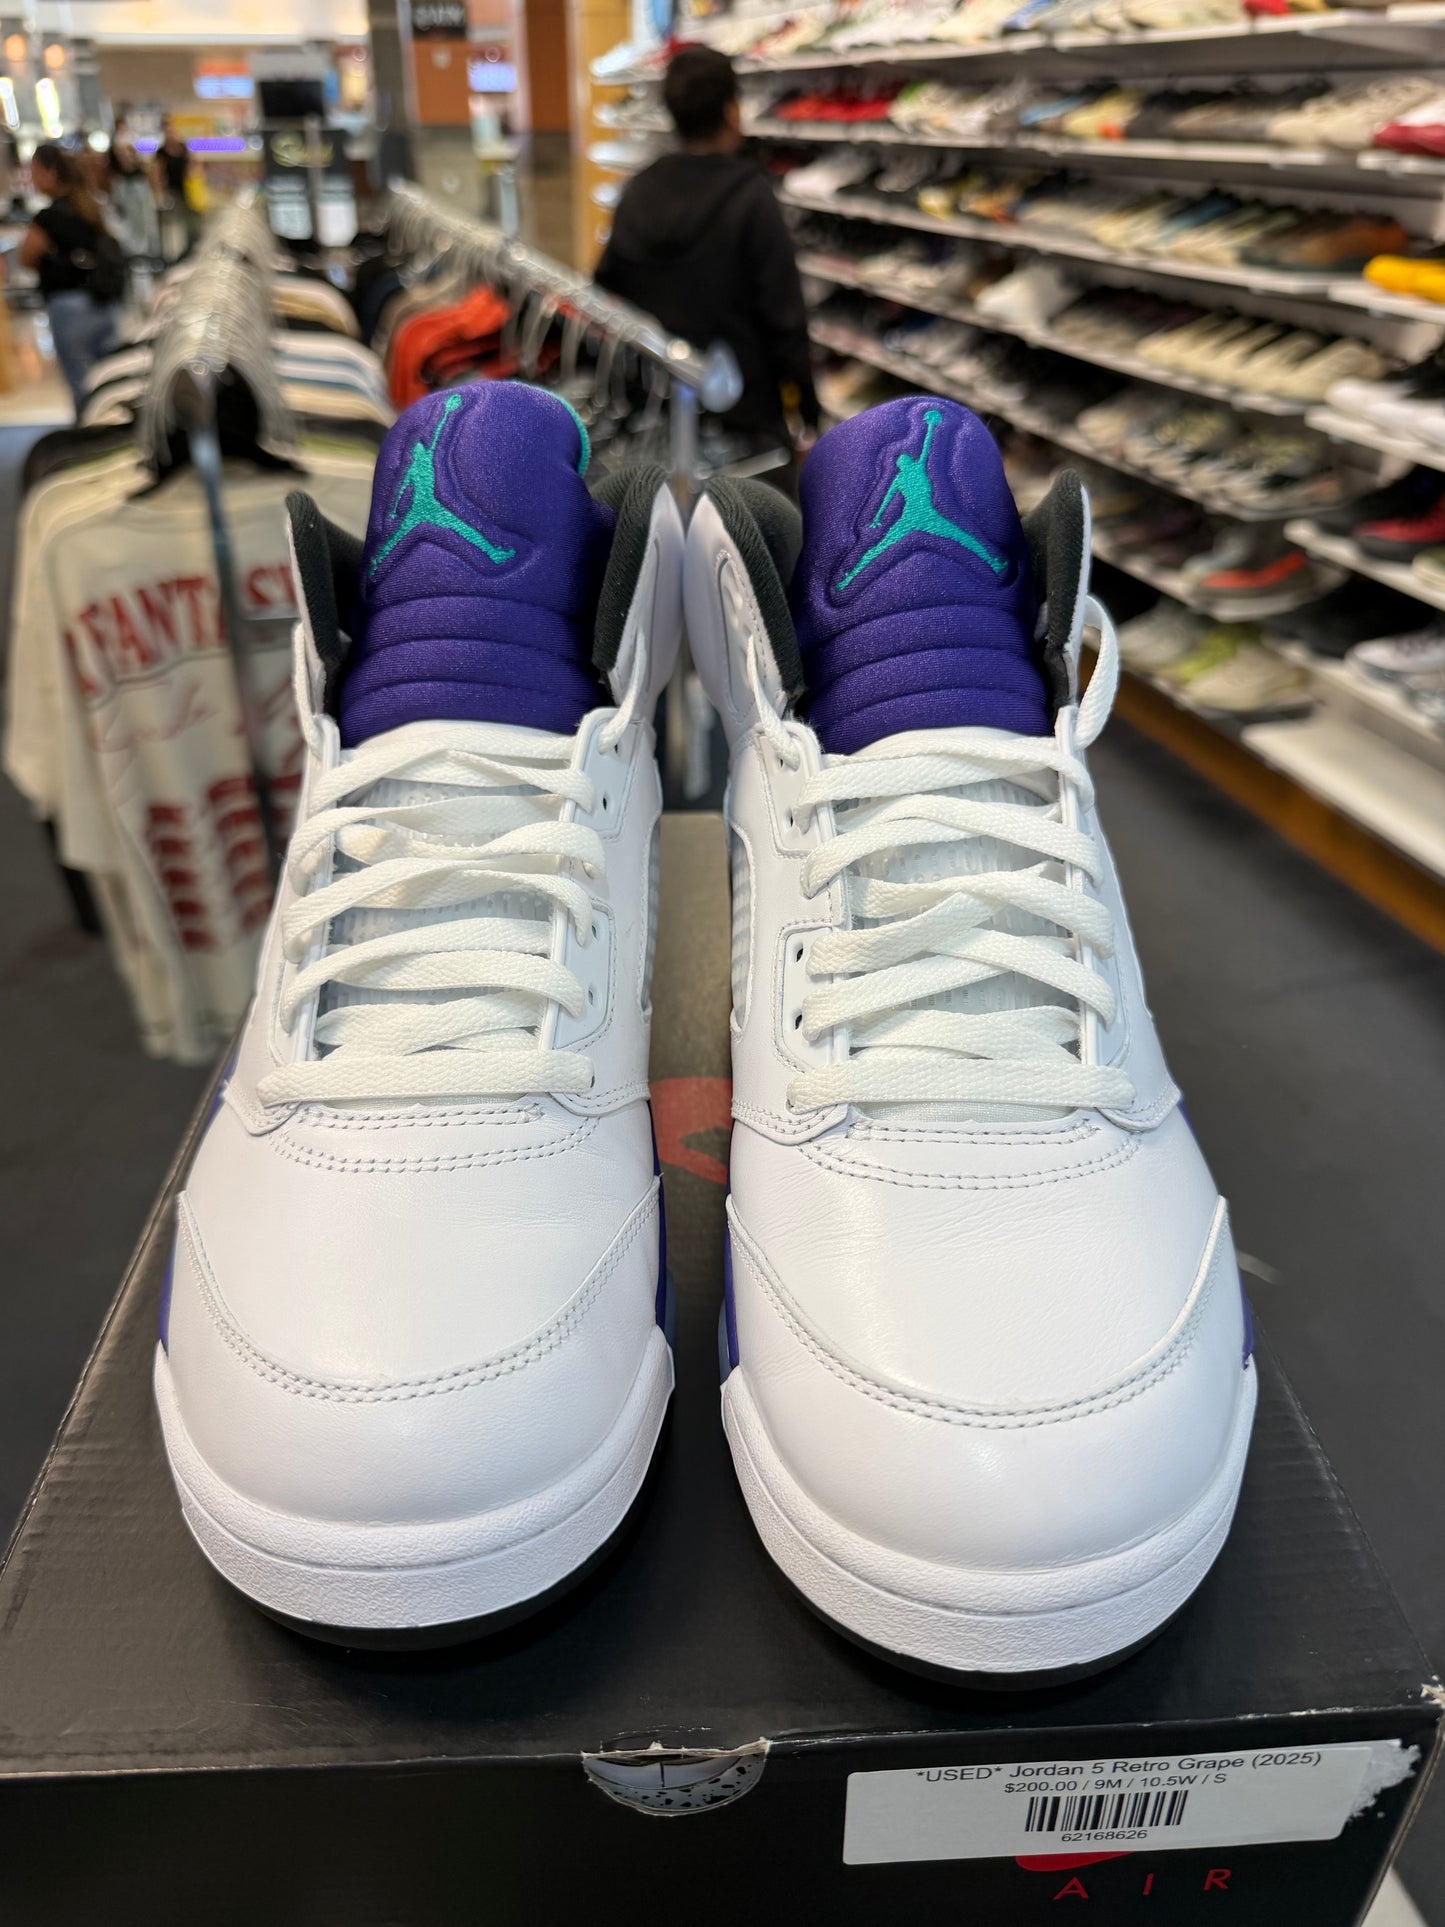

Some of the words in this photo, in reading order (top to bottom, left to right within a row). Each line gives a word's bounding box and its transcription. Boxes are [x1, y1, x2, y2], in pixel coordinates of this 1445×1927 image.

[1009, 1764, 1084, 1778] Jordan
[1091, 1762, 1105, 1774] 5
[1112, 1760, 1170, 1773] Retro
[1178, 1757, 1245, 1771] Grape
[1251, 1751, 1322, 1770] (2025)
[1004, 1780, 1078, 1793] $200.00
[1082, 1780, 1090, 1790] /
[1094, 1778, 1122, 1789] 9M
[1127, 1777, 1134, 1788] /
[1140, 1775, 1198, 1787] 10.5W
[1201, 1774, 1209, 1784] /
[1213, 1773, 1227, 1784] S
[1061, 1829, 1148, 1842] 62168626
[1053, 1868, 1233, 1900] AIR
